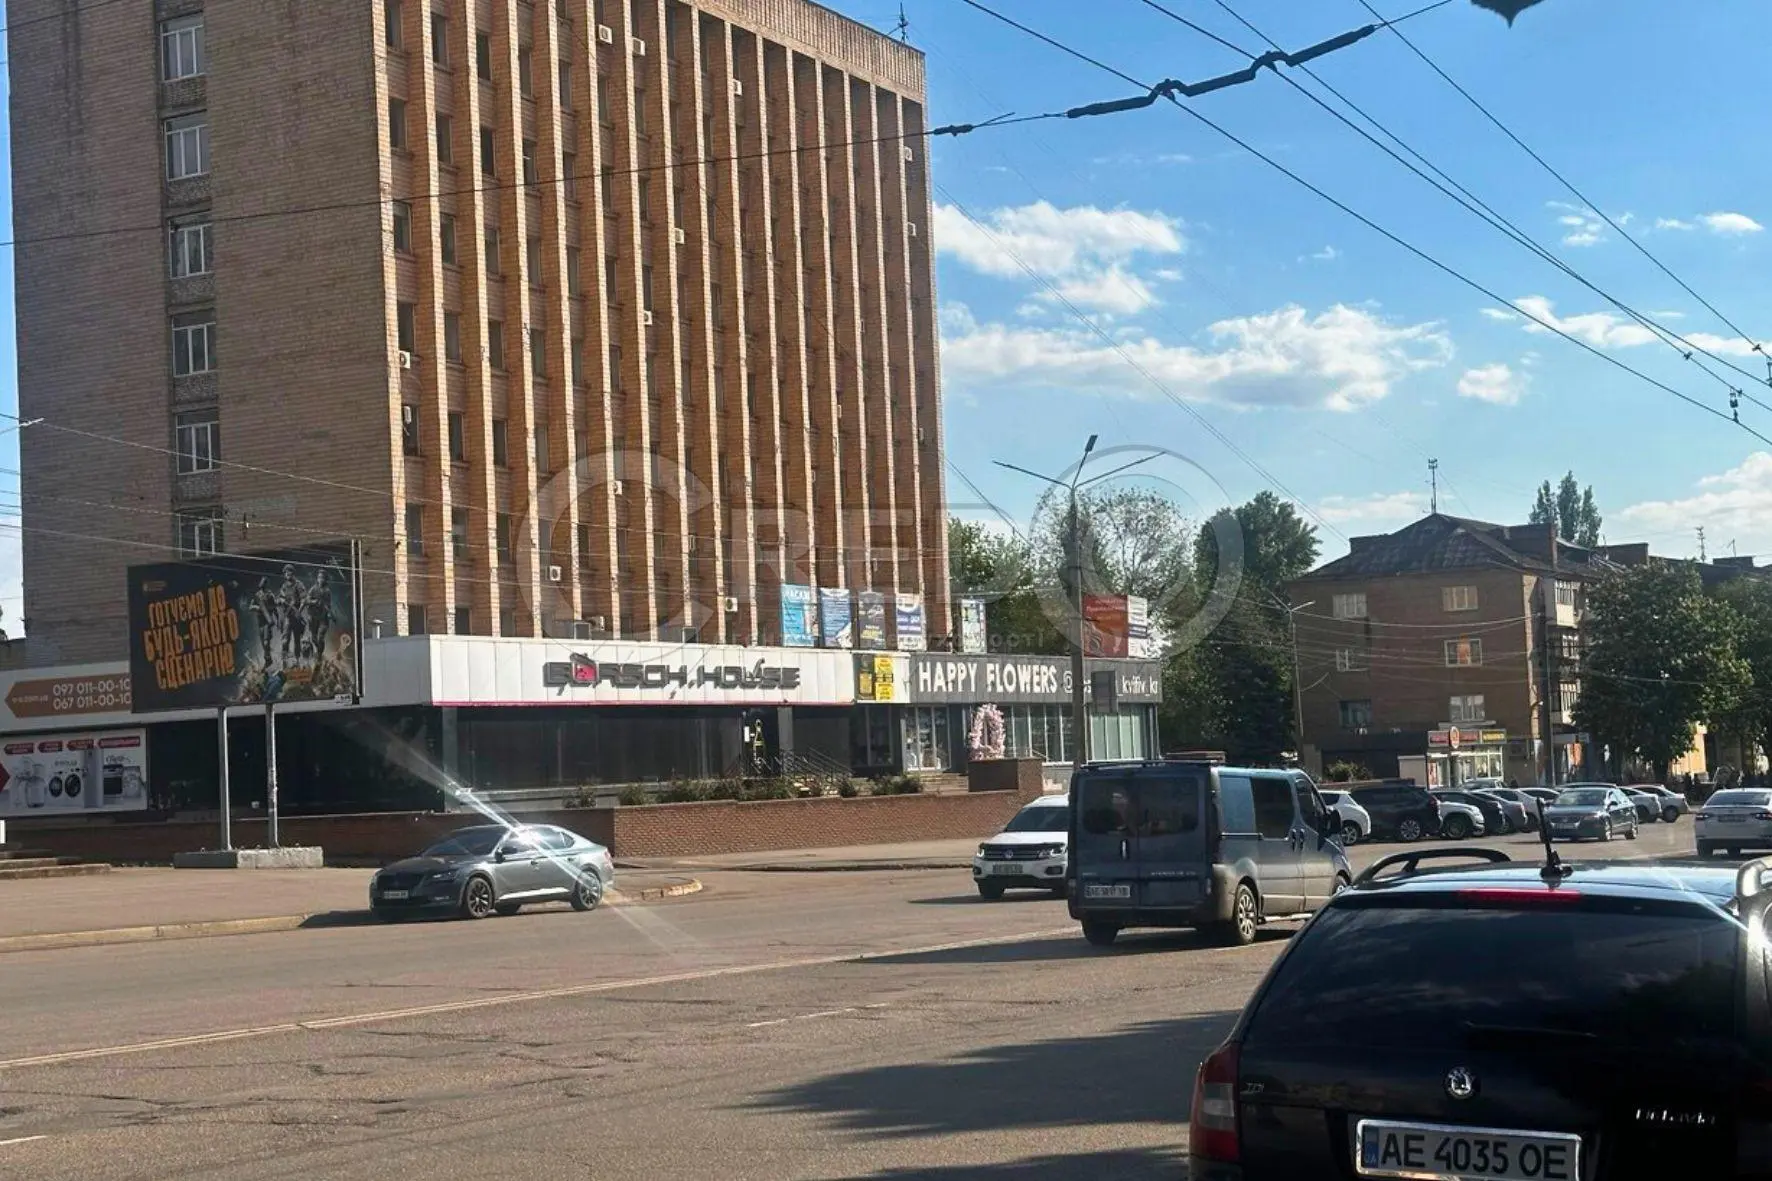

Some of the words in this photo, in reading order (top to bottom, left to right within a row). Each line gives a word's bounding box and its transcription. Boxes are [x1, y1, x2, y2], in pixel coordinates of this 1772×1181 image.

[149, 592, 206, 628] ГОТУЄМО
[208, 584, 226, 614] ДО
[143, 608, 240, 662] БУДЬ-ЯКОГО
[52, 683, 72, 697] 097
[76, 678, 131, 694] 011-00-10
[155, 642, 235, 690] СЦЕНАРІЮ
[918, 661, 977, 693] HAPPY
[986, 662, 1058, 694] FLOWERS
[53, 697, 72, 711] 067
[77, 692, 131, 709] 011-00-10
[1380, 1132, 1427, 1168] AE
[1434, 1136, 1509, 1174] 4035
[1518, 1143, 1568, 1180] OE
